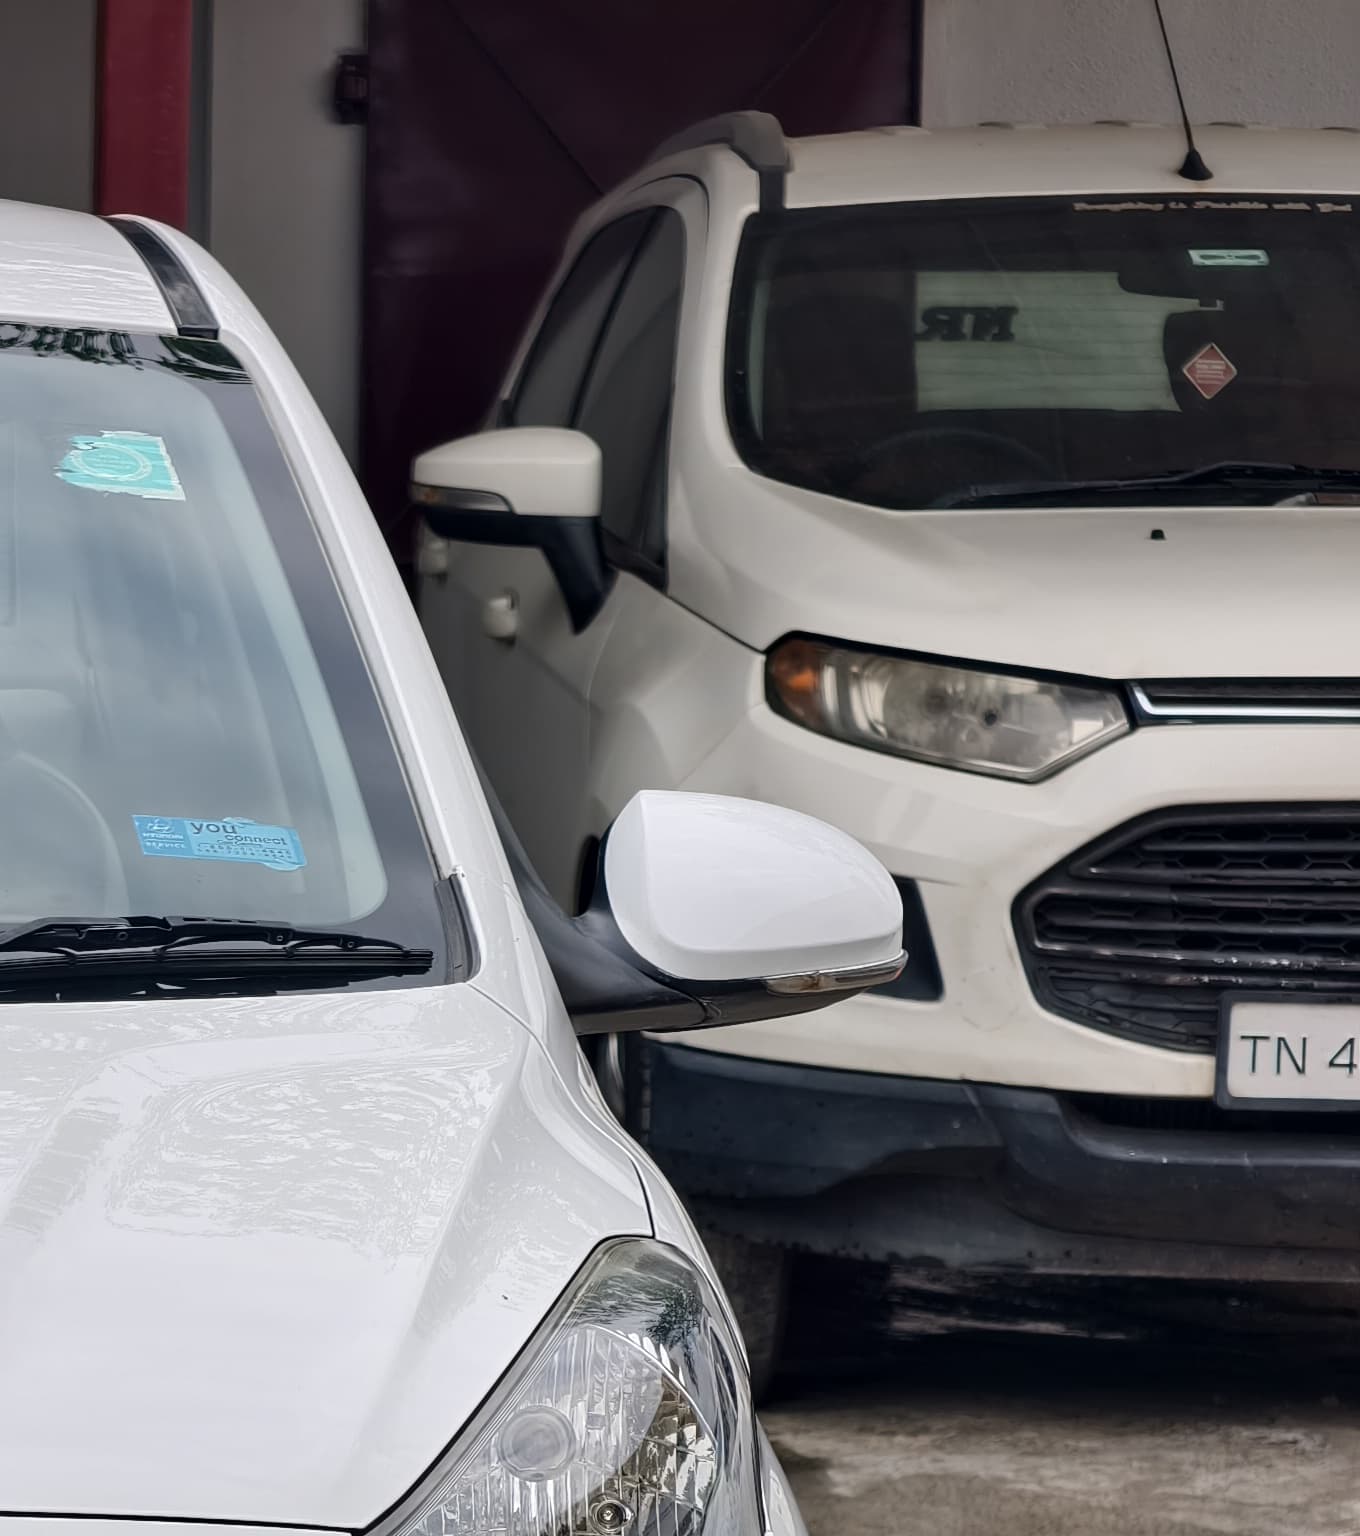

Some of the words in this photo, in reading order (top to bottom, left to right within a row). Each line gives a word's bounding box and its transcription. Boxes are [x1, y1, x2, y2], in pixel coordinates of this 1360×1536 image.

[189, 821, 239, 836] you
[224, 833, 288, 846] connect
[1239, 1035, 1308, 1075] TN
[1328, 1037, 1358, 1075] 4
